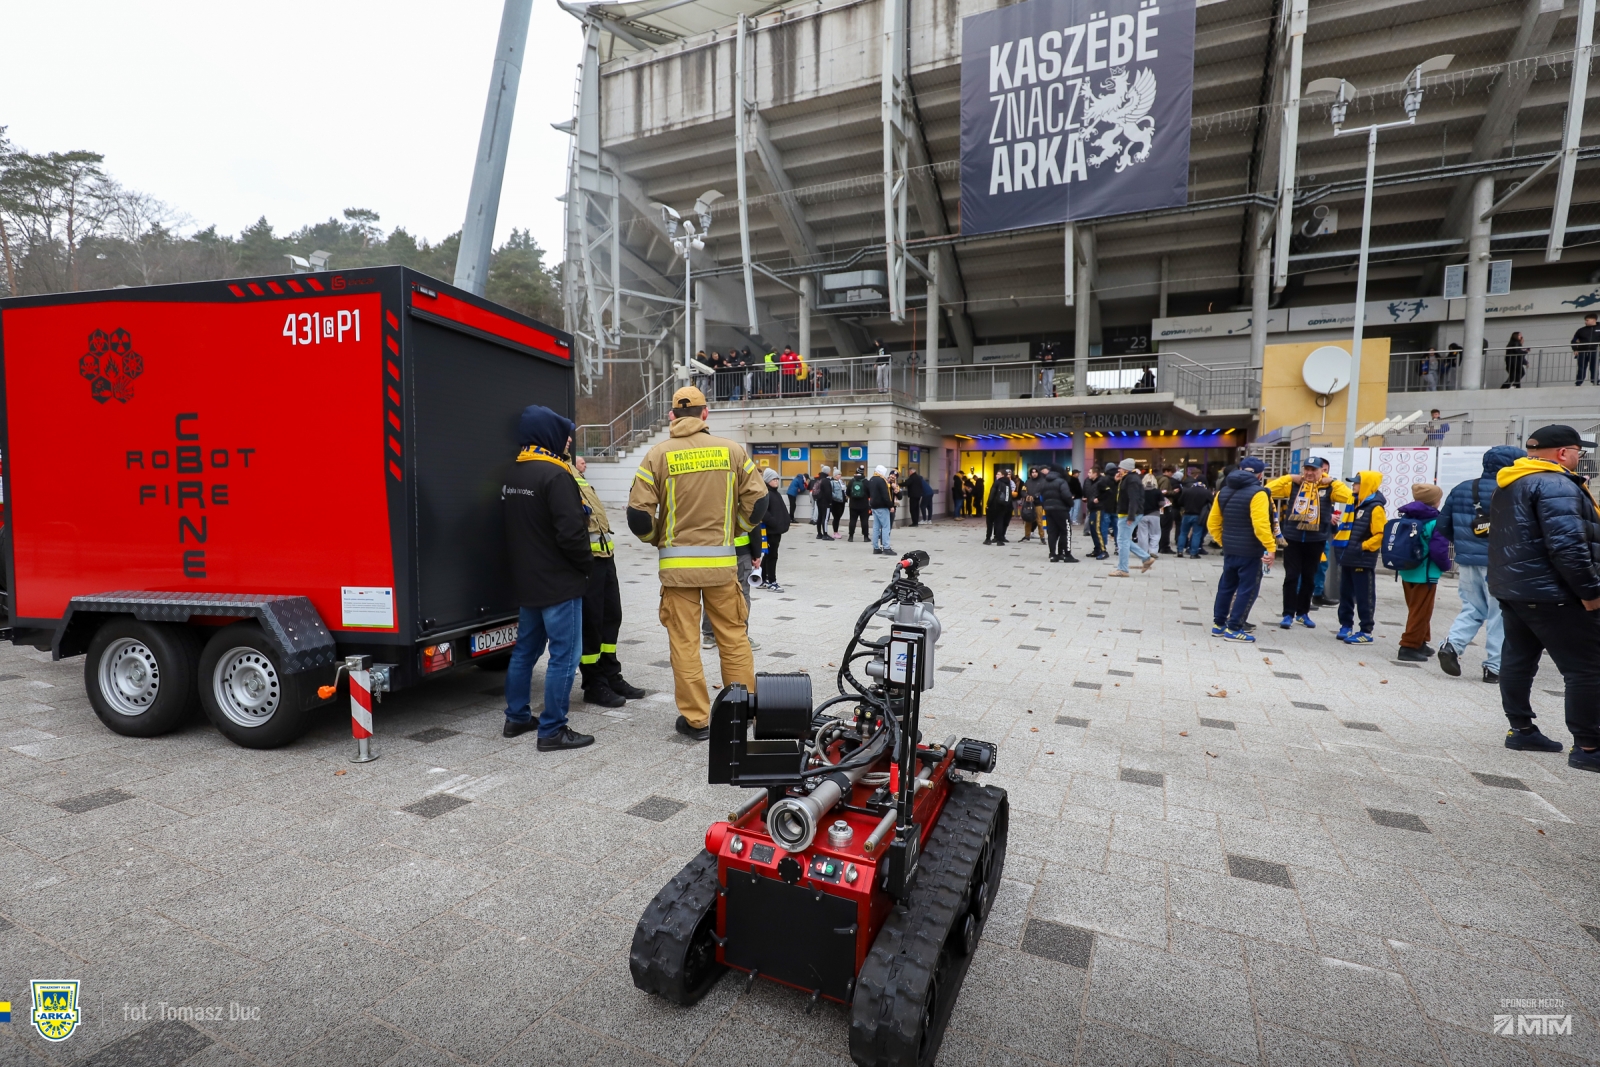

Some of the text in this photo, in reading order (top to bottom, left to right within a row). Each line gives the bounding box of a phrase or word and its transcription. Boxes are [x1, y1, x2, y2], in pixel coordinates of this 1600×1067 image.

[989, 0, 1160, 93] KASZËBË
[989, 132, 1088, 196] ARKA
[1485, 303, 1534, 313] NIAsport.pl
[1307, 314, 1368, 326] GDYNIAsporl
[1130, 336, 1147, 349] 23
[982, 413, 1162, 431] OFICJALNY SKLEP ARKA GDYNIA
[126, 446, 256, 474] ROBOT
[139, 481, 230, 509] FIRE
[175, 412, 207, 578] CBRNE
[477, 633, 492, 650] GD
